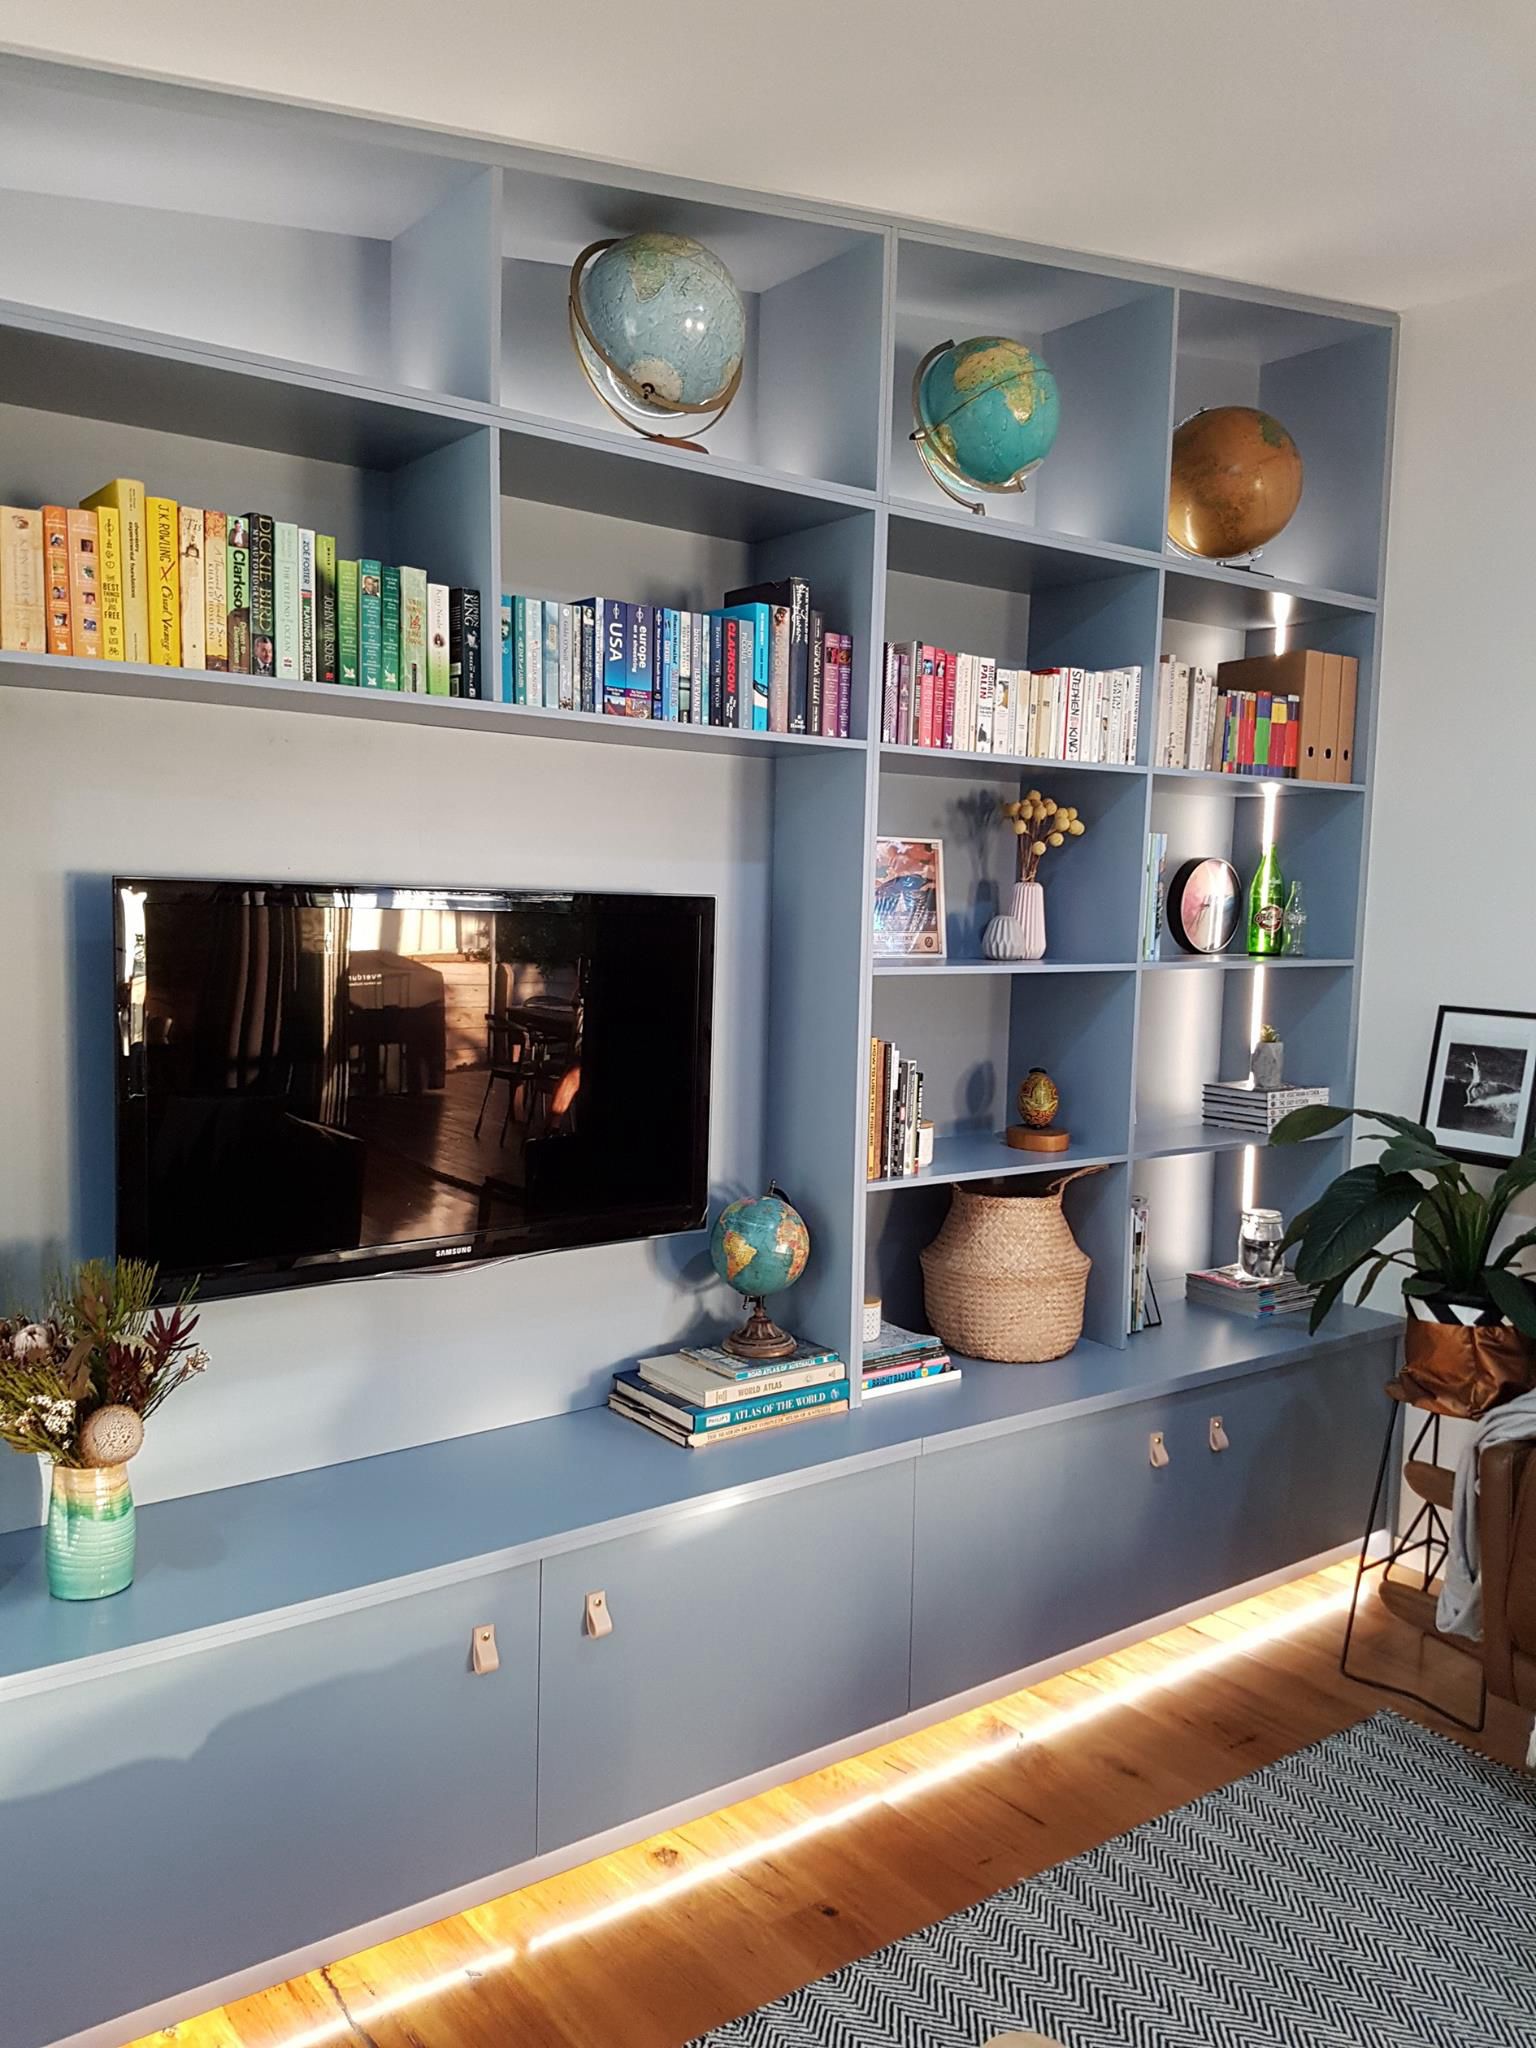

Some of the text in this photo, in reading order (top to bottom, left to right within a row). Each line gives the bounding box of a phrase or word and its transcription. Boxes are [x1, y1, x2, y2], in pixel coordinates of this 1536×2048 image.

[158, 522, 172, 563] ROWLING
[103, 583, 119, 592] BEST
[252, 529, 260, 620] MY AUTOBIOGRAPHY
[258, 517, 273, 632] DICKIE BIRD
[303, 557, 311, 585] FOSTER
[104, 611, 120, 620] FREE
[160, 585, 174, 652] Casual Vacancy
[212, 592, 227, 626] Splendid
[464, 593, 474, 626] KING
[303, 605, 312, 674] PLAYING THE FIELD
[323, 595, 335, 667] JOHN MARSDEN
[609, 623, 623, 662] USA
[637, 625, 648, 669] europe
[693, 628, 701, 658] broken
[727, 622, 737, 693] CLARKSON
[813, 640, 823, 676] WOMEN
[693, 686, 701, 712] EVANS
[979, 664, 988, 700] PALIN
[987, 665, 995, 700] MICHAEL
[1068, 671, 1082, 754] STEPHEN KING
[435, 1245, 472, 1258] SAMSUNG
[763, 1366, 779, 1375] ATLAS
[871, 1370, 917, 1386] BRIGHT BAZAAR
[733, 1392, 826, 1421] ATLAS OF THE WORLD
[738, 1381, 783, 1397] WORLD ATLAS
